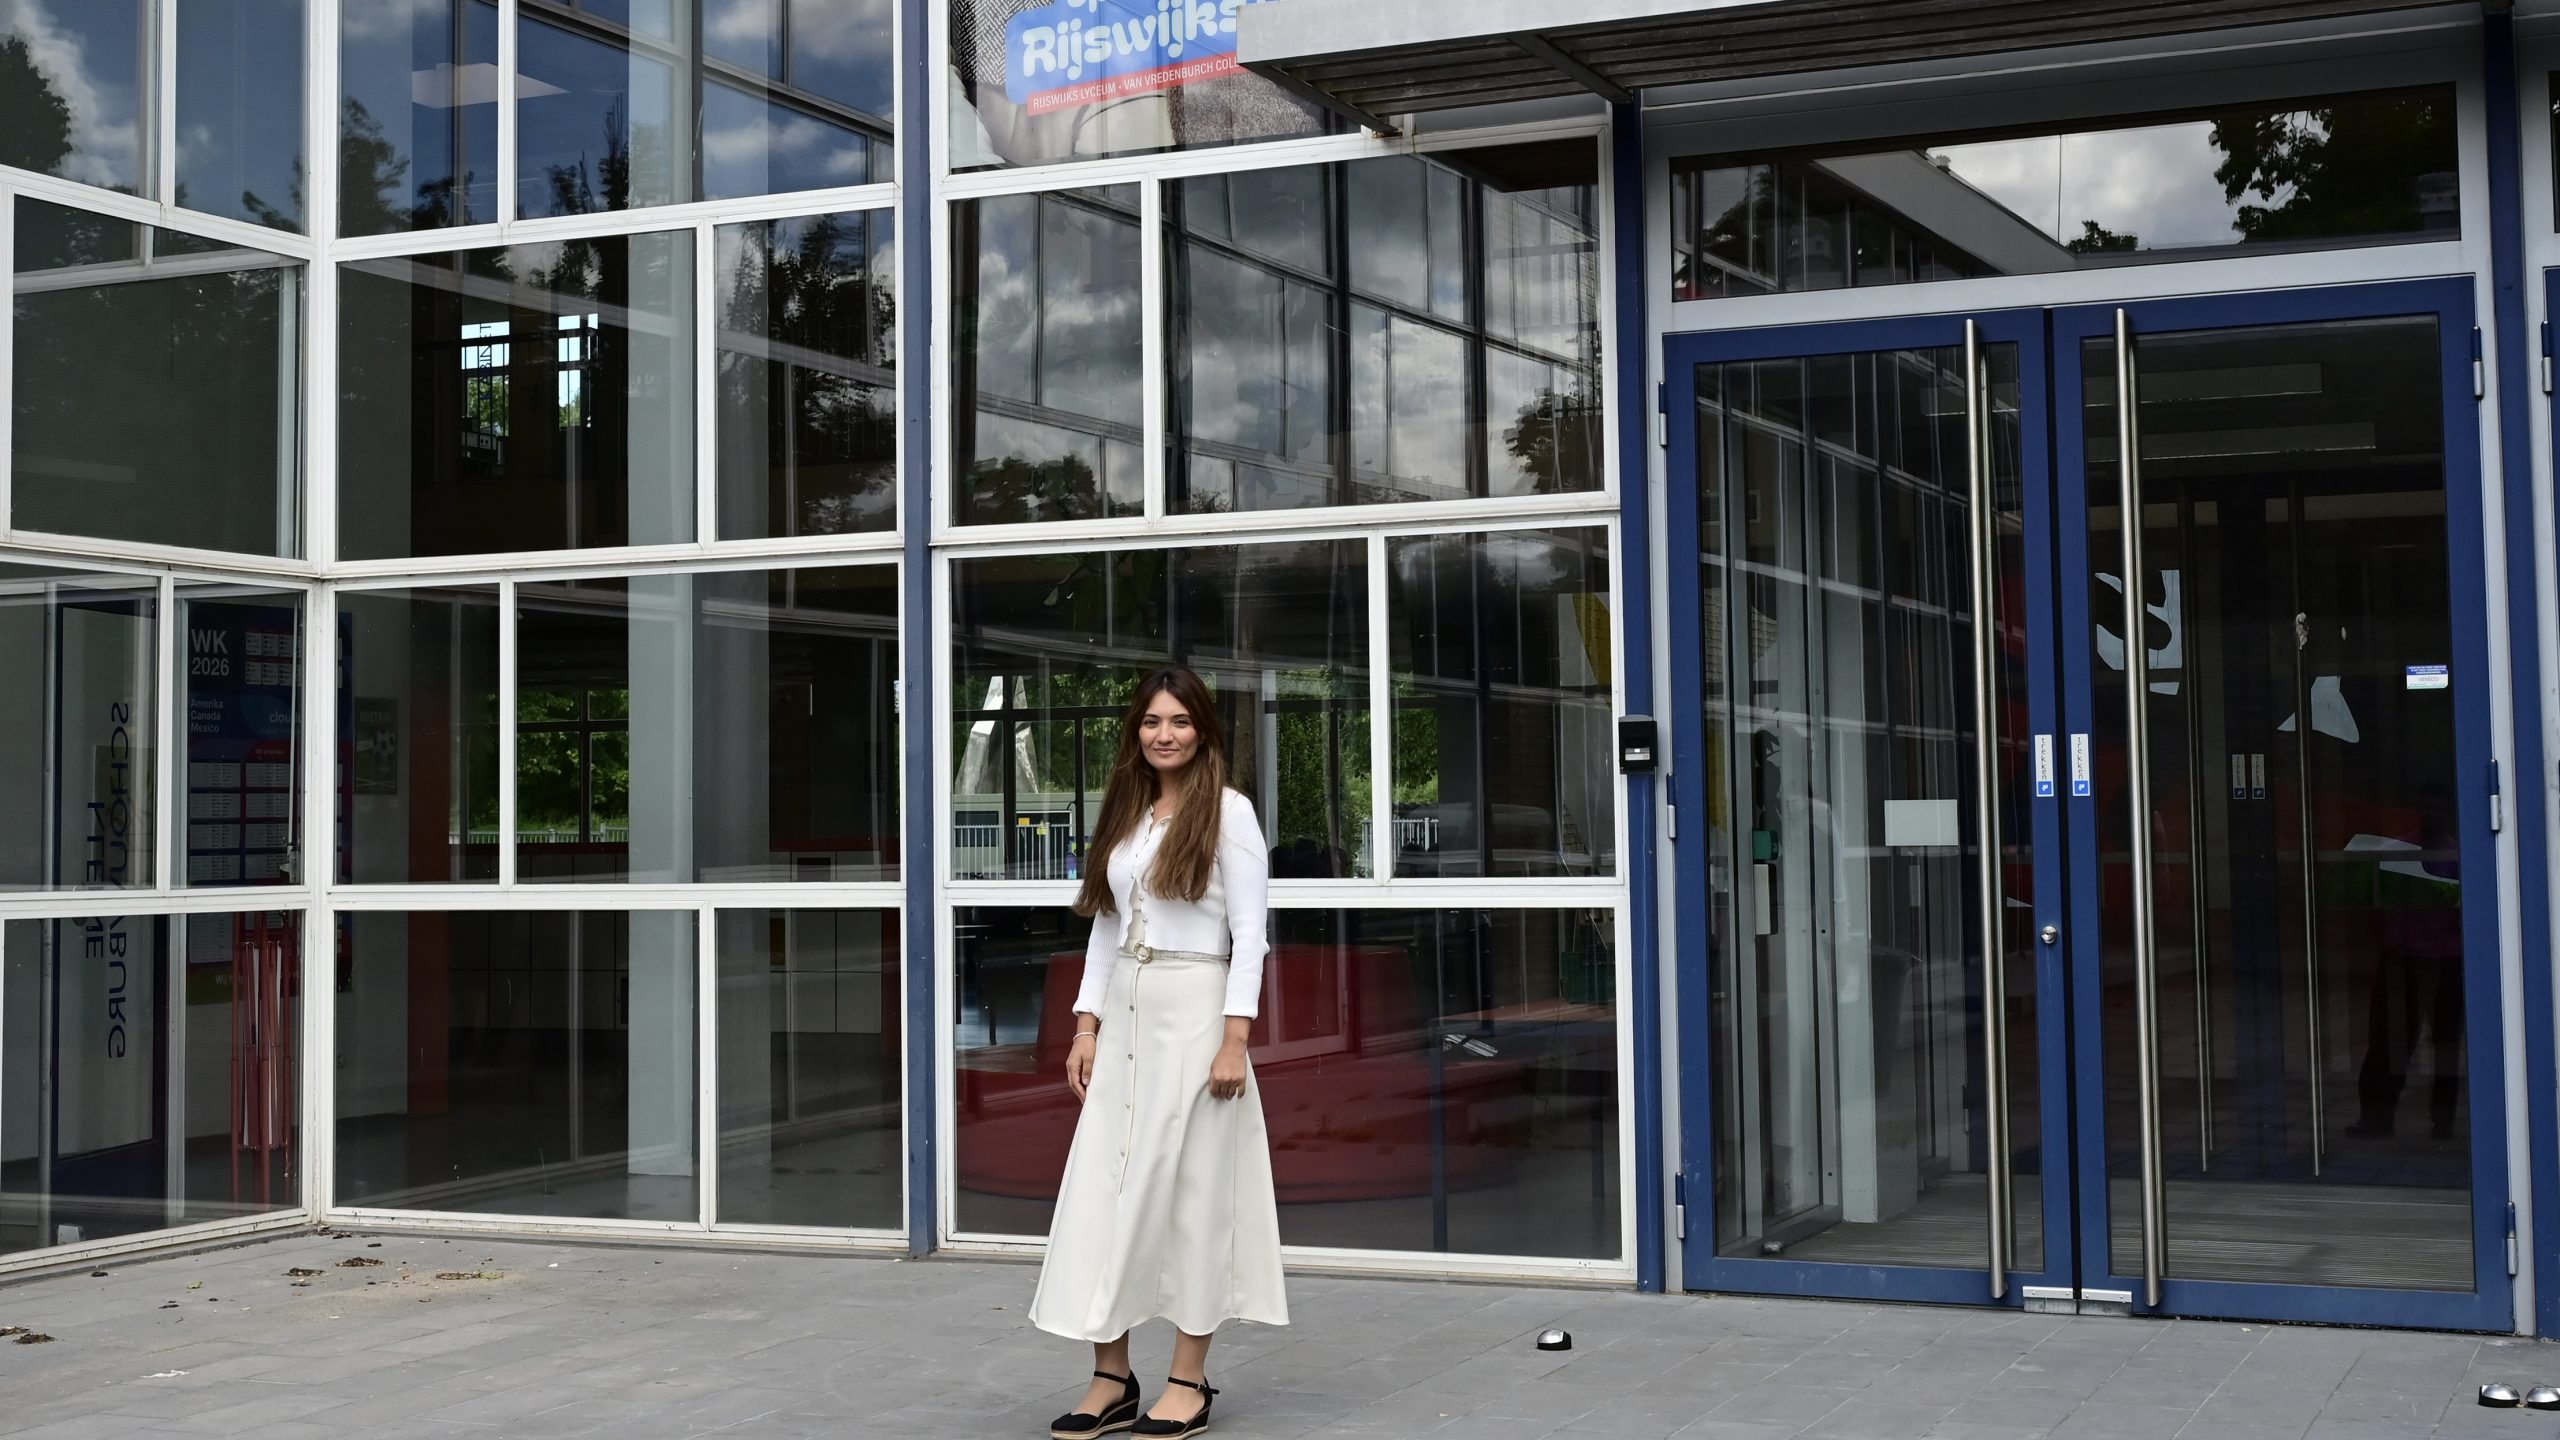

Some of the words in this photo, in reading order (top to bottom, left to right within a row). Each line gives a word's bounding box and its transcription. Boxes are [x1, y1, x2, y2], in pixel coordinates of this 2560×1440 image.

[1033, 89, 1079, 110] RIJSWIJKS
[1080, 82, 1116, 101] LYCEUM
[1123, 77, 1143, 91] VAN
[1144, 63, 1214, 86] VREDENBURCH
[190, 628, 228, 655] WK
[191, 657, 230, 677] 2026
[190, 698, 224, 710] Amerika
[190, 710, 221, 721] Canada
[190, 721, 220, 733] Mexico
